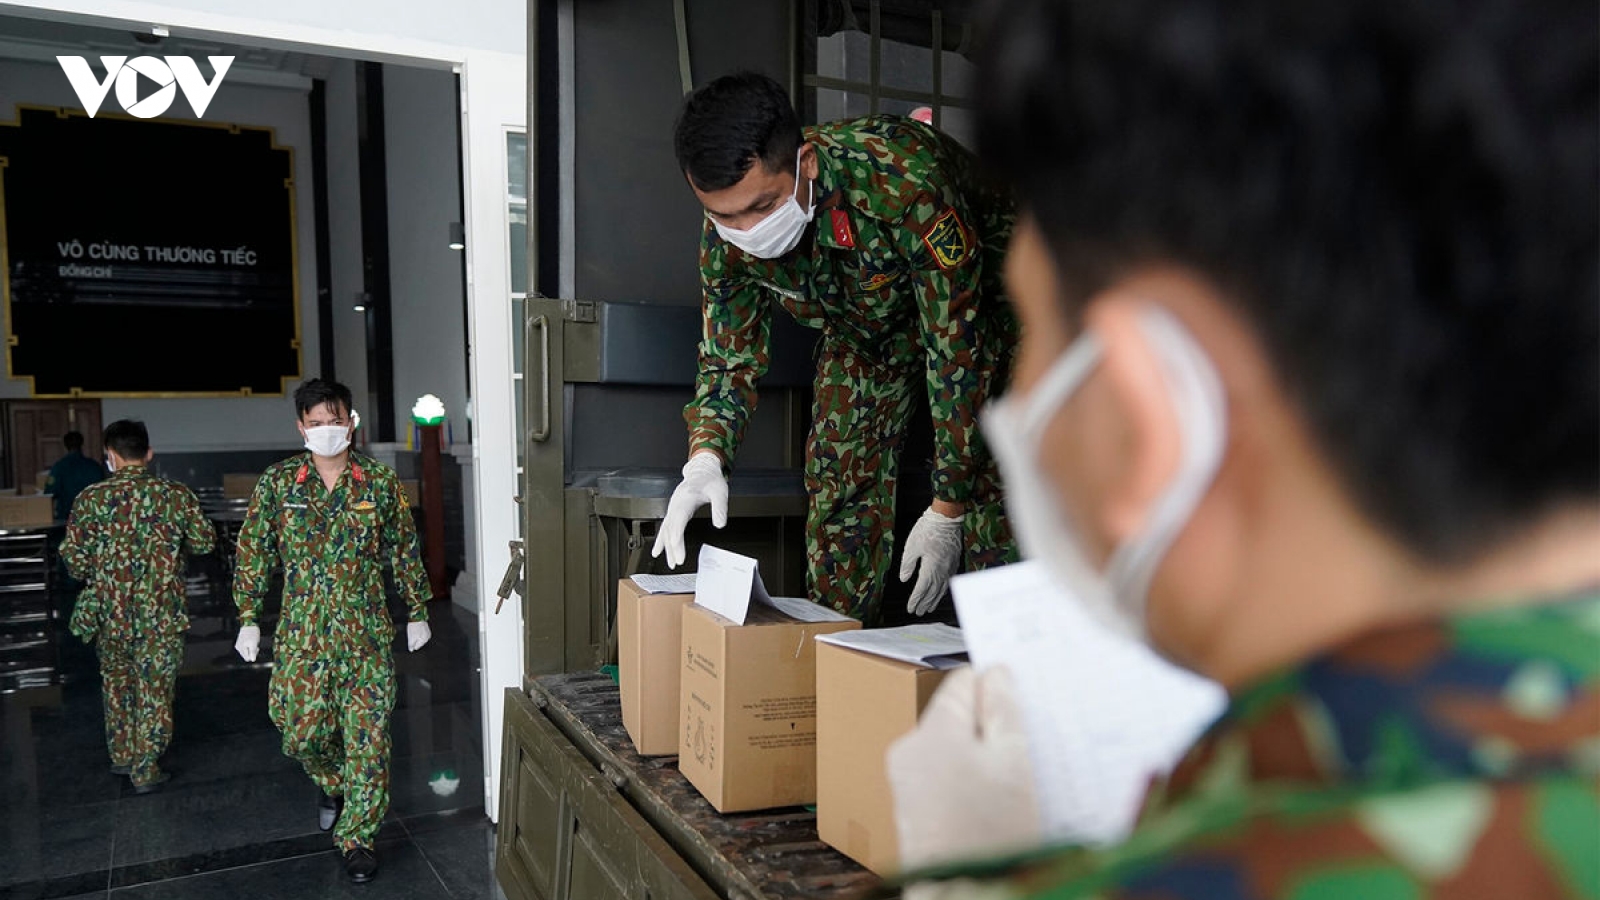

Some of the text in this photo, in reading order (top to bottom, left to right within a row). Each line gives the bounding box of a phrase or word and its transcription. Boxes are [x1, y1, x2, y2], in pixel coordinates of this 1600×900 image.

[57, 239, 257, 266] VÔ CÙNG THƯƠNG TIẾC
